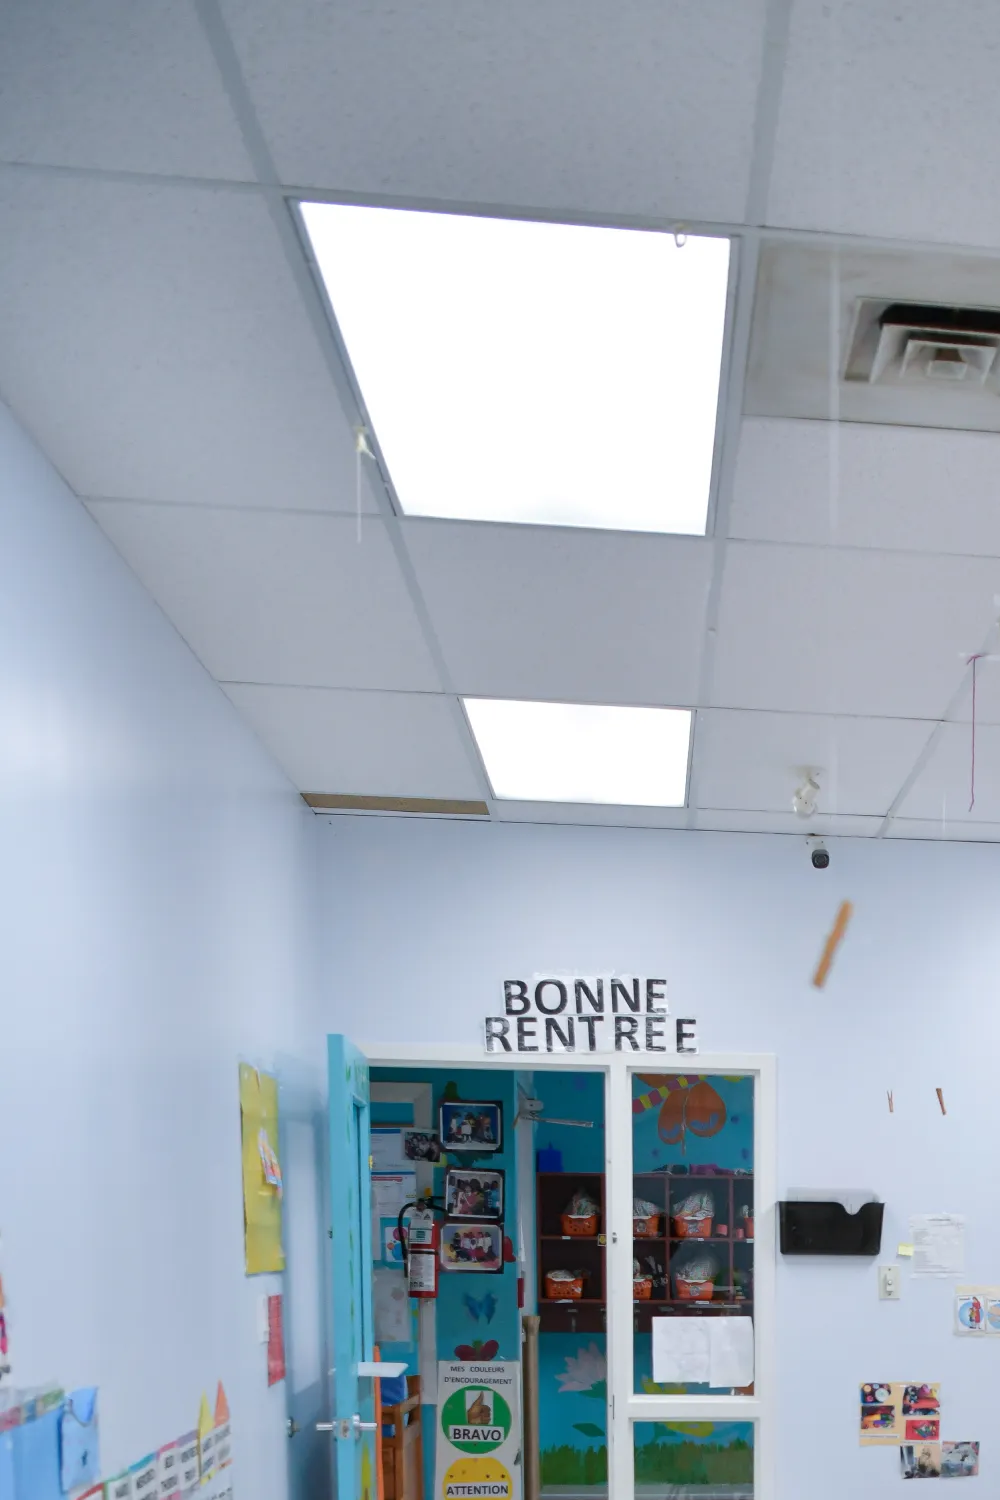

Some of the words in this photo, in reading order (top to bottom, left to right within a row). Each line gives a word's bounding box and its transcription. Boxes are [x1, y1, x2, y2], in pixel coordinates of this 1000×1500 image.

[503, 978, 668, 1016] BONNE
[485, 1015, 698, 1054] RENTREE
[444, 1376, 512, 1385] D'ENCOURAGEMENT
[453, 1428, 502, 1441] BRAVO
[446, 1485, 509, 1495] ATTENTION
